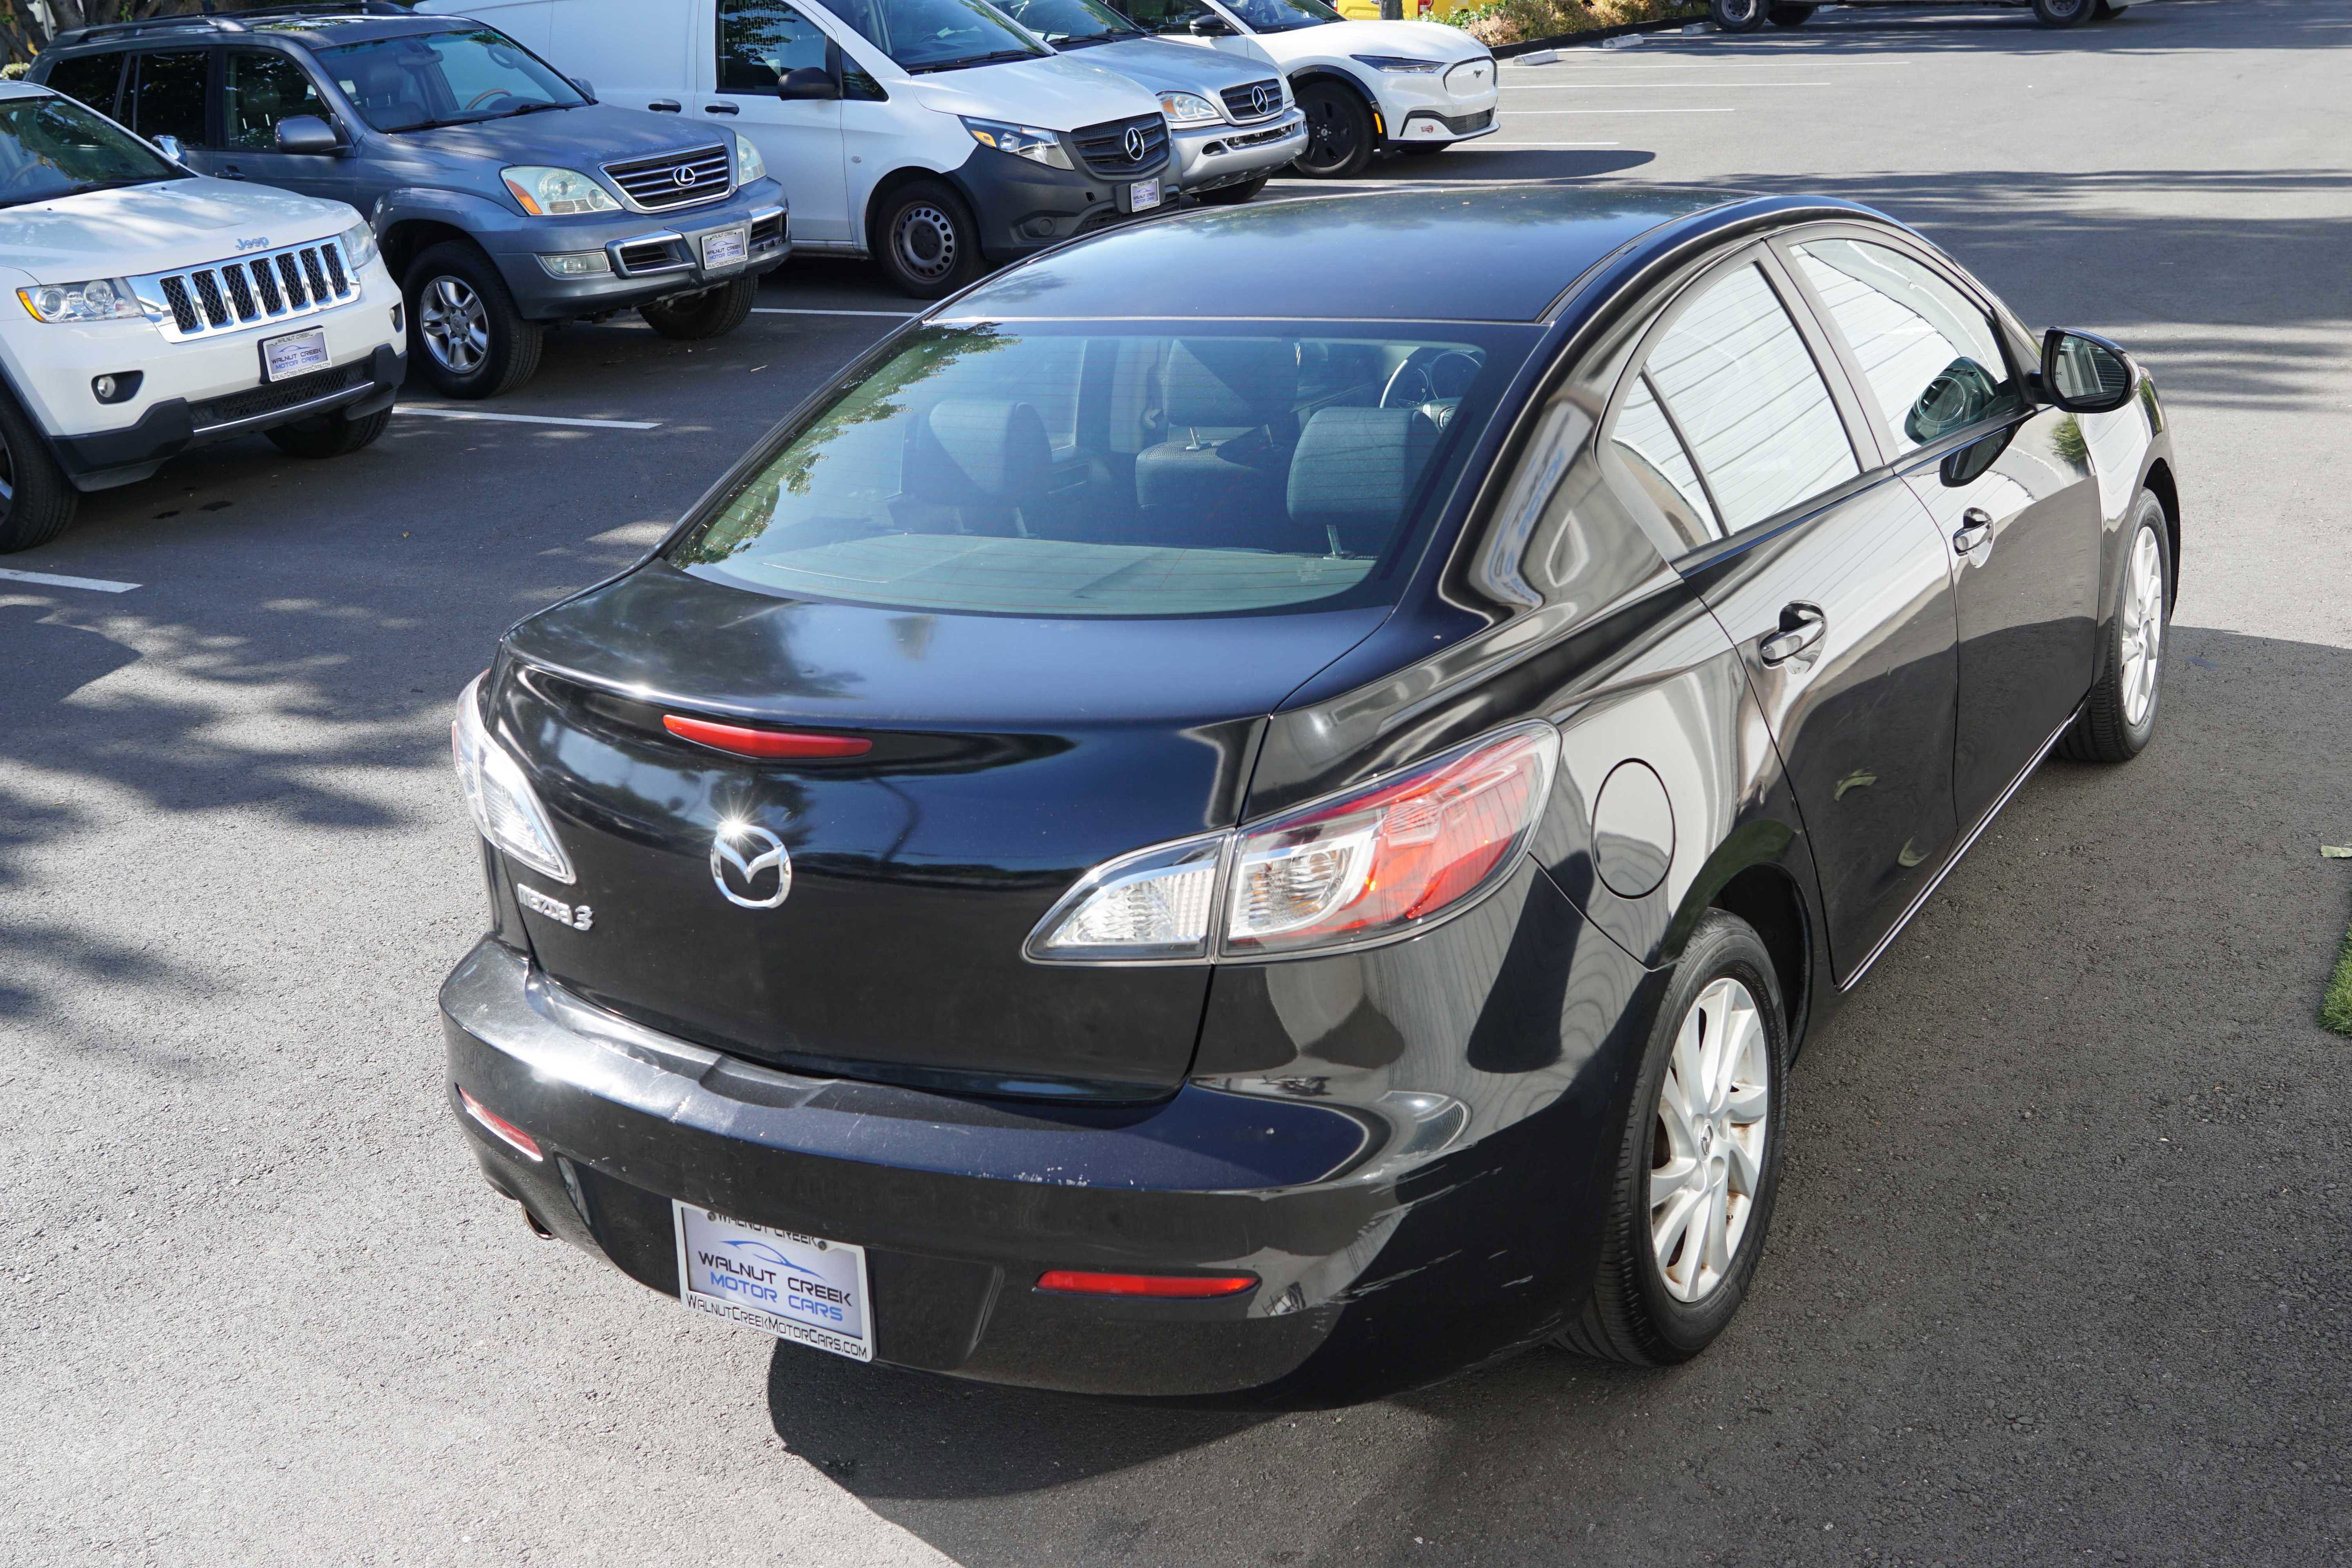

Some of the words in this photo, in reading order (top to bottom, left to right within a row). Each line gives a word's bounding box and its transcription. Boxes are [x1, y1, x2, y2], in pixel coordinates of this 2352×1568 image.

[235, 237, 269, 250] Jeep
[277, 335, 294, 343] WALNUT
[271, 354, 297, 364] WALNUT
[300, 347, 322, 356] CREEK
[275, 360, 298, 370] MOTOR
[301, 355, 320, 363] CARS
[698, 1251, 776, 1284] WALNUT
[788, 1277, 853, 1307] CREEK
[710, 1271, 777, 1303] MOTOR
[788, 1294, 843, 1322] CARS
